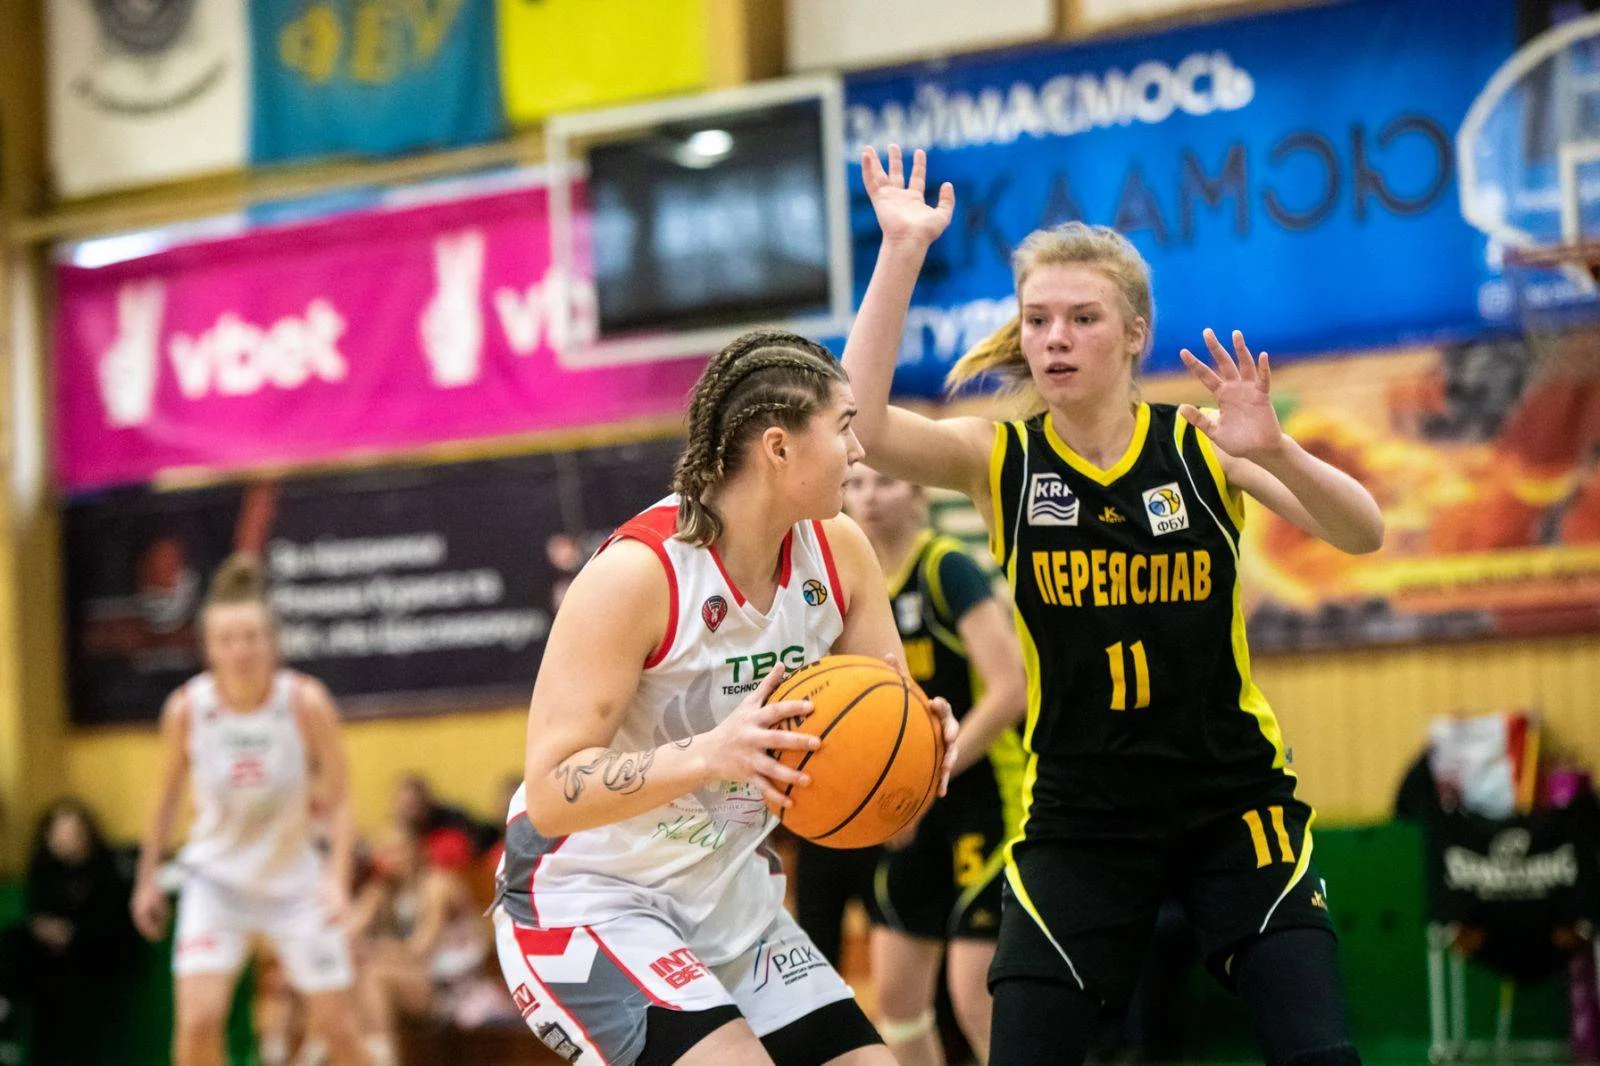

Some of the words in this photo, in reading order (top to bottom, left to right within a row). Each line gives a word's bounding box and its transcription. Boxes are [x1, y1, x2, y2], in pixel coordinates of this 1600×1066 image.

[168, 296, 349, 400] vbet
[1157, 515, 1185, 532] ФБУ
[1032, 548, 1212, 608] ПЕРЕЯСЛАВ
[722, 681, 763, 695] TECHNO
[726, 644, 805, 684] TBG
[1105, 639, 1151, 712] 11
[1241, 804, 1297, 869] 11
[772, 944, 821, 974] РДК
